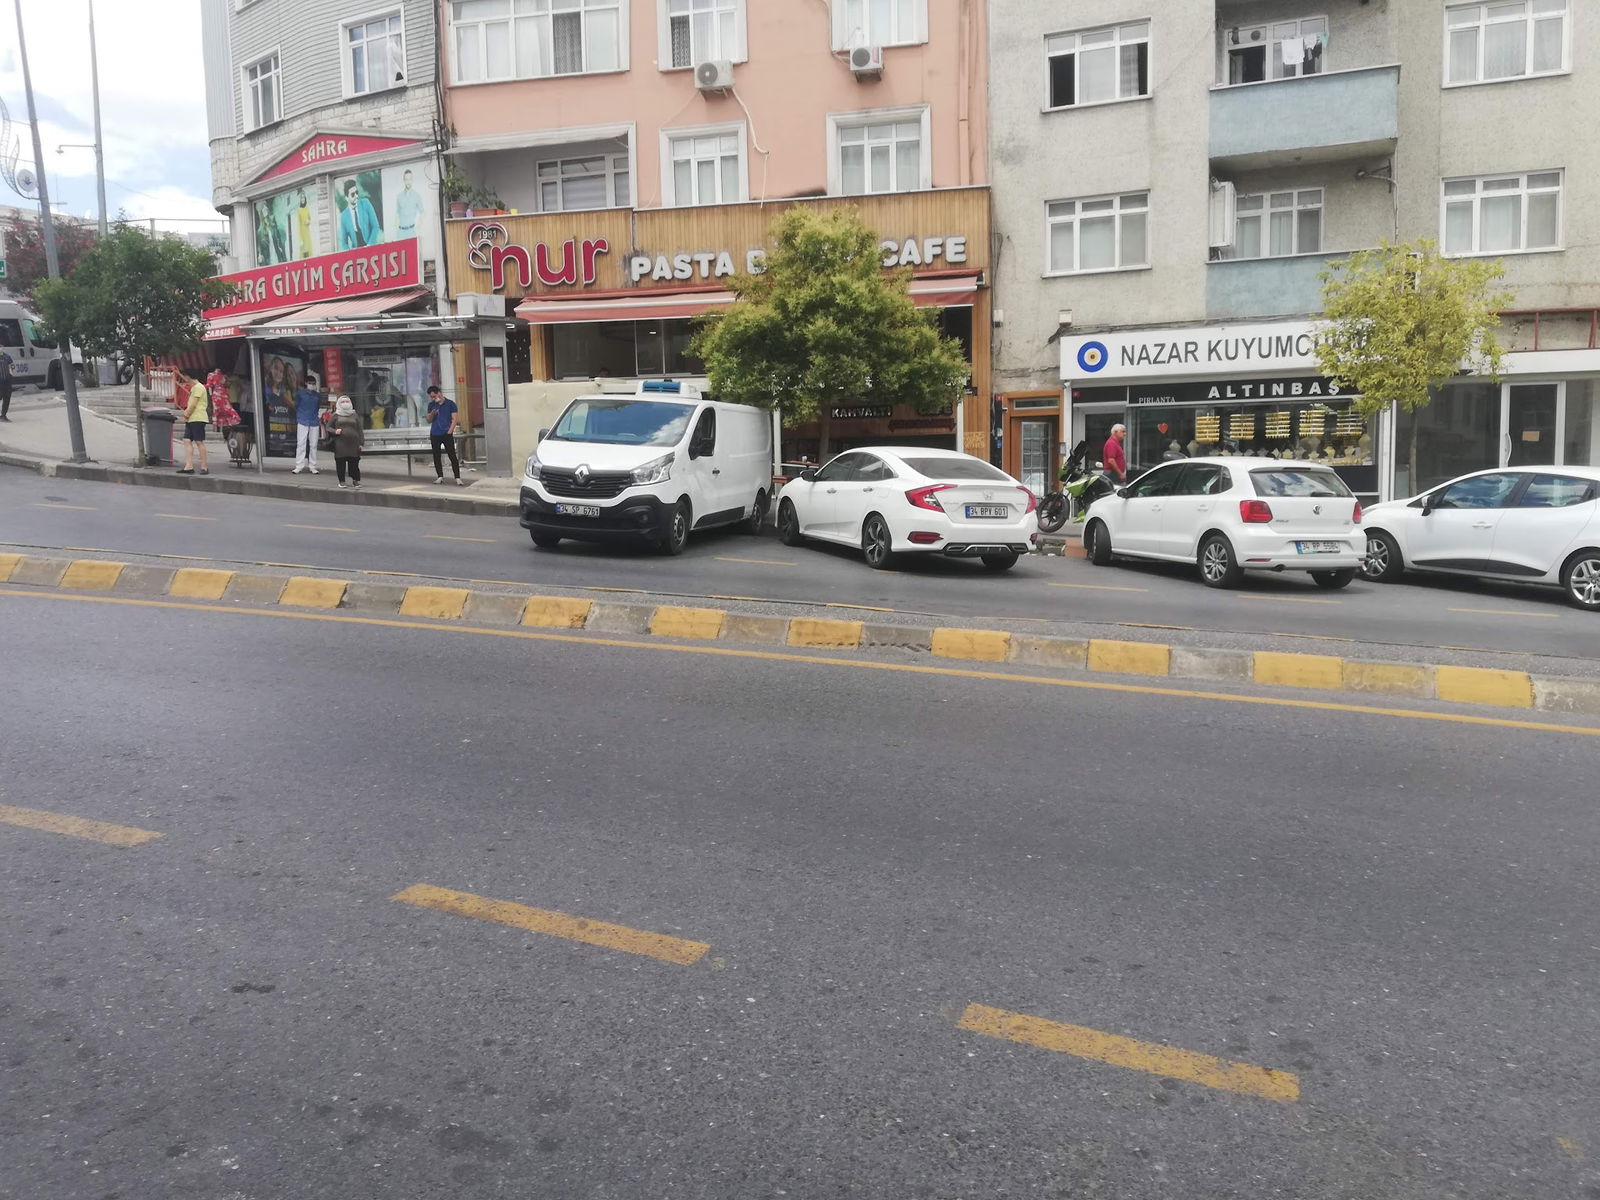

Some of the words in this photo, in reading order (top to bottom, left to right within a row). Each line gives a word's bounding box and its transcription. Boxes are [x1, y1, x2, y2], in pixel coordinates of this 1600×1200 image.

[302, 140, 347, 163] SAHRA
[477, 230, 497, 239] 1981
[490, 238, 608, 290] nur
[631, 252, 735, 282] PASTA
[880, 236, 967, 267] CAFE
[272, 263, 324, 297] GİYİM
[330, 250, 407, 292] ÇARŞISI
[1121, 341, 1199, 366] NAZAR
[1208, 382, 1340, 399] ALTINBAŞ
[970, 507, 978, 515] 34
[994, 507, 1006, 516] 601
